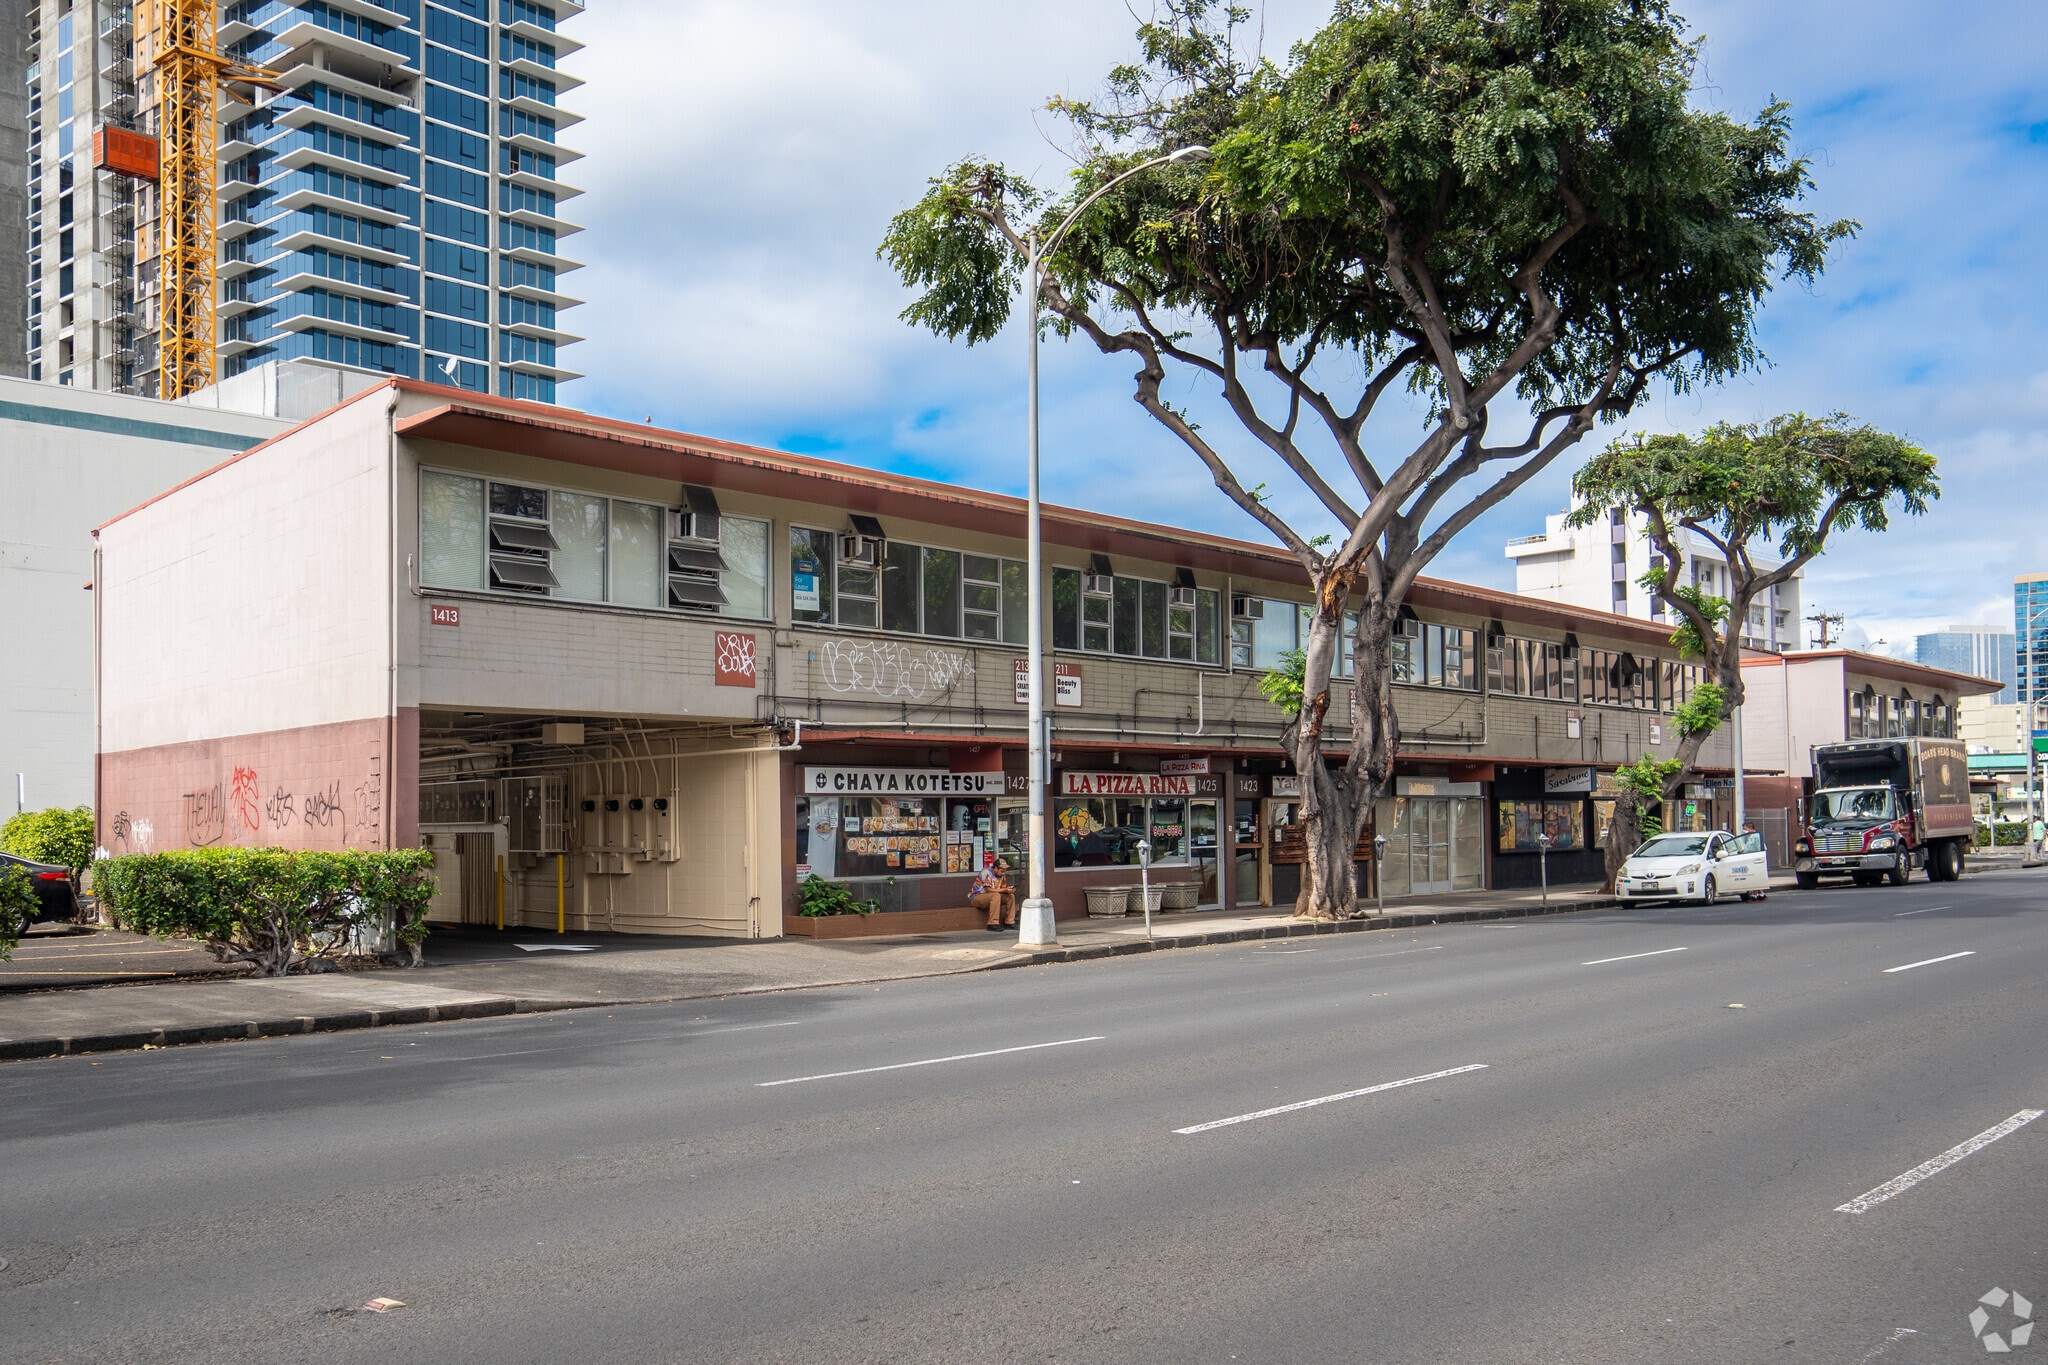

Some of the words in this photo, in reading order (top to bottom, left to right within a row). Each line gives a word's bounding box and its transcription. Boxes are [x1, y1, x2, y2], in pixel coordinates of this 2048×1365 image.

[433, 608, 458, 622] 1413
[1015, 660, 1029, 671] 213
[1055, 664, 1068, 674] 211
[1057, 678, 1077, 688] Beauty
[1057, 687, 1071, 695] Bliss
[1921, 747, 1937, 762] BOAR'S
[1936, 747, 1950, 757] HEAD
[1950, 748, 1966, 763] BRAND
[1172, 763, 1189, 771] PIZZA
[1191, 762, 1206, 770] RINA
[834, 773, 899, 791] CHAYA
[905, 774, 985, 791] KOTETSU
[1007, 776, 1029, 790] 1427
[1068, 774, 1093, 793] LA
[1096, 775, 1147, 794] PIZZA
[1149, 776, 1190, 794] RINA
[1548, 770, 1590, 789] Sasabune
[1705, 779, 1721, 787] Ellen
[1198, 780, 1217, 792] 1425
[1240, 780, 1258, 792] 1423
[974, 804, 991, 813] OPEN
[1934, 812, 1965, 820] PROVISIONS
